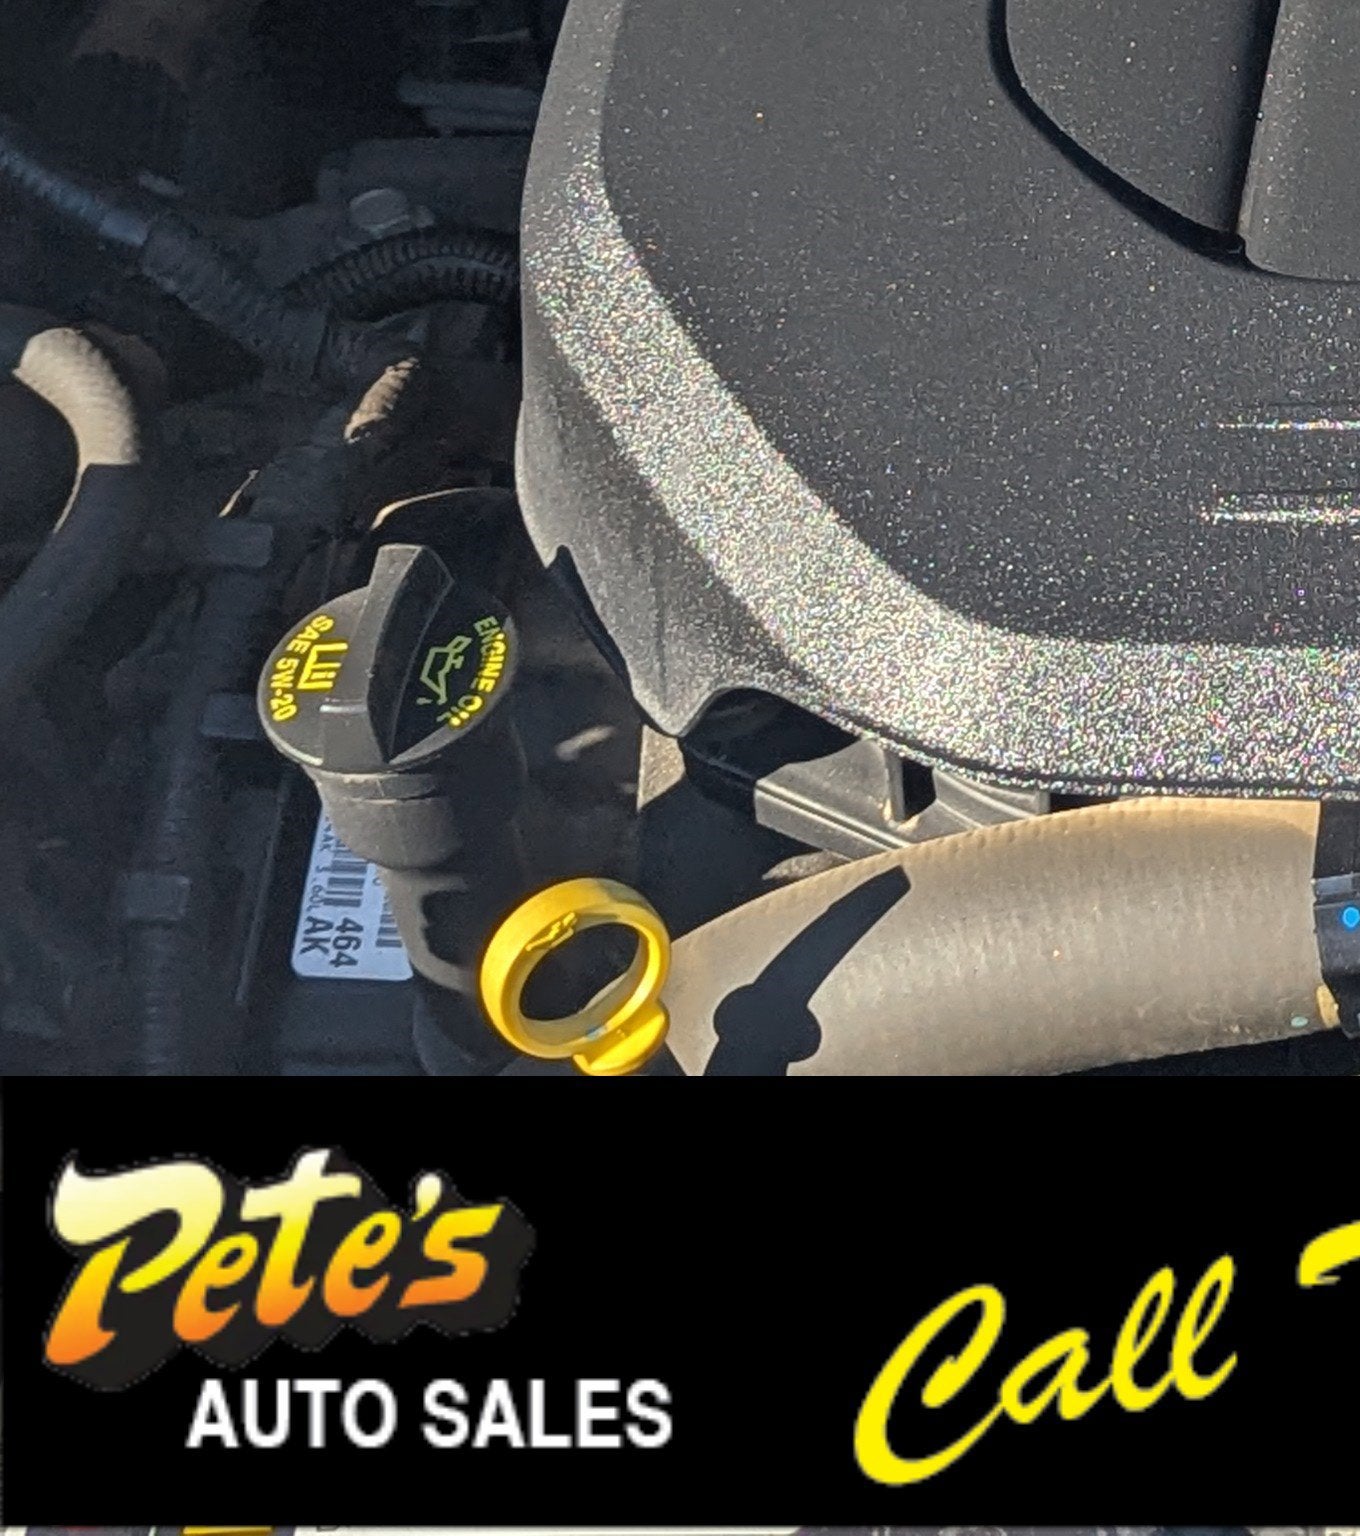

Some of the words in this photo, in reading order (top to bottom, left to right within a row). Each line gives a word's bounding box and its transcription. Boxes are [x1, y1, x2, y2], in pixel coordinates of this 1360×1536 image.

[286, 615, 334, 654] SAE
[470, 616, 506, 693] ENGINE
[270, 657, 300, 722] 5W-20
[436, 695, 483, 726] OIL
[301, 916, 335, 955] AK
[329, 917, 364, 968] 464
